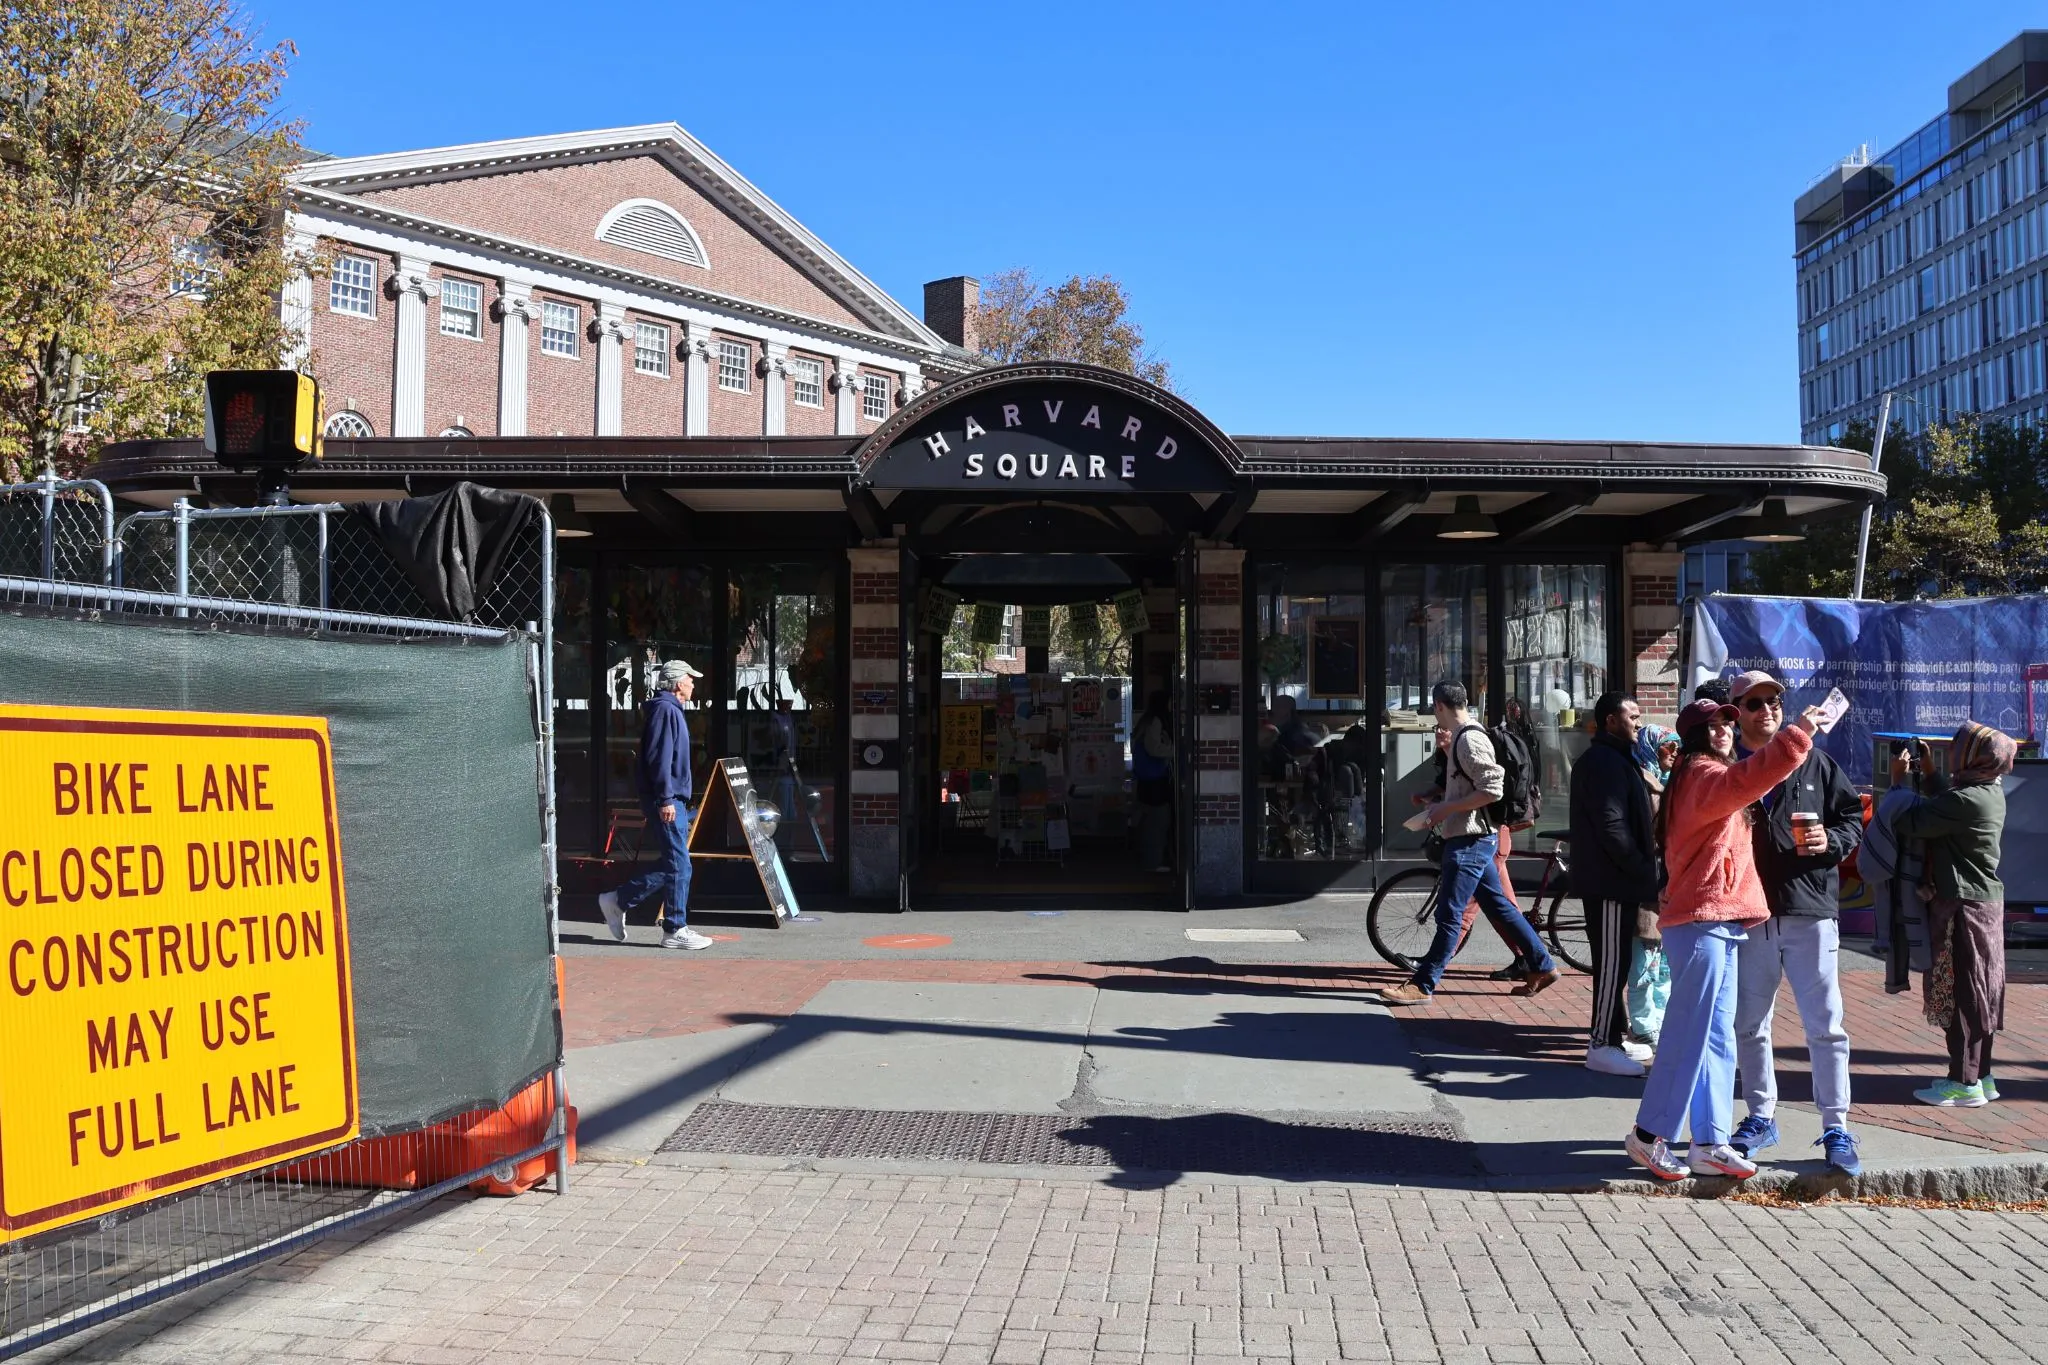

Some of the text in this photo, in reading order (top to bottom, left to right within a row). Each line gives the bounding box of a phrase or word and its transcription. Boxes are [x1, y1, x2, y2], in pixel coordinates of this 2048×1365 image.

[925, 400, 1178, 460] HARVARD
[965, 453, 1136, 479] SQUARE
[1779, 656, 1805, 669] KiOSK
[1807, 657, 1816, 669] is
[1818, 660, 1824, 670] a
[1826, 660, 1882, 674] partnership
[1799, 678, 1816, 688] and
[1819, 678, 1833, 688] the
[1835, 676, 1888, 692] Cambridge
[53, 761, 274, 816] BIKE LANE
[1, 836, 321, 907] CLOSED DURING
[8, 909, 325, 997] CONSTRUCTION
[86, 991, 275, 1074] MAY USE
[68, 1063, 300, 1167] FULL LANE
